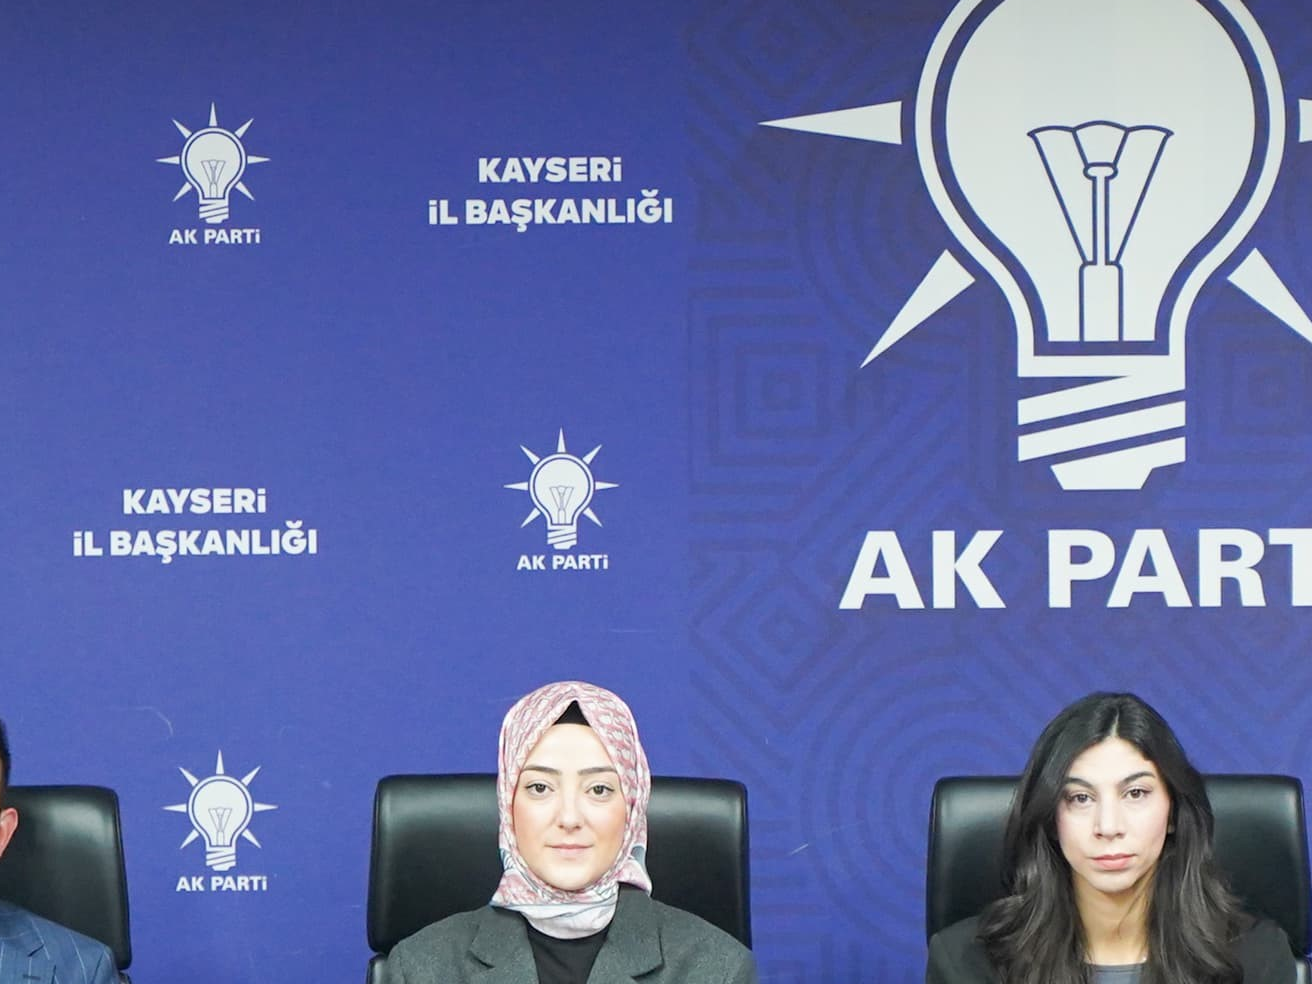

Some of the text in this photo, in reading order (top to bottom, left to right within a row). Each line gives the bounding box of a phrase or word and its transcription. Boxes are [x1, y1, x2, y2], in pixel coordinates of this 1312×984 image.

[465, 189, 673, 233] BAŞKANLIĞI
[168, 228, 198, 245] AK
[110, 519, 318, 564] BAŞKANLIĞI
[516, 554, 546, 571] AK
[838, 529, 1007, 610] AK
[176, 876, 205, 892] AK
